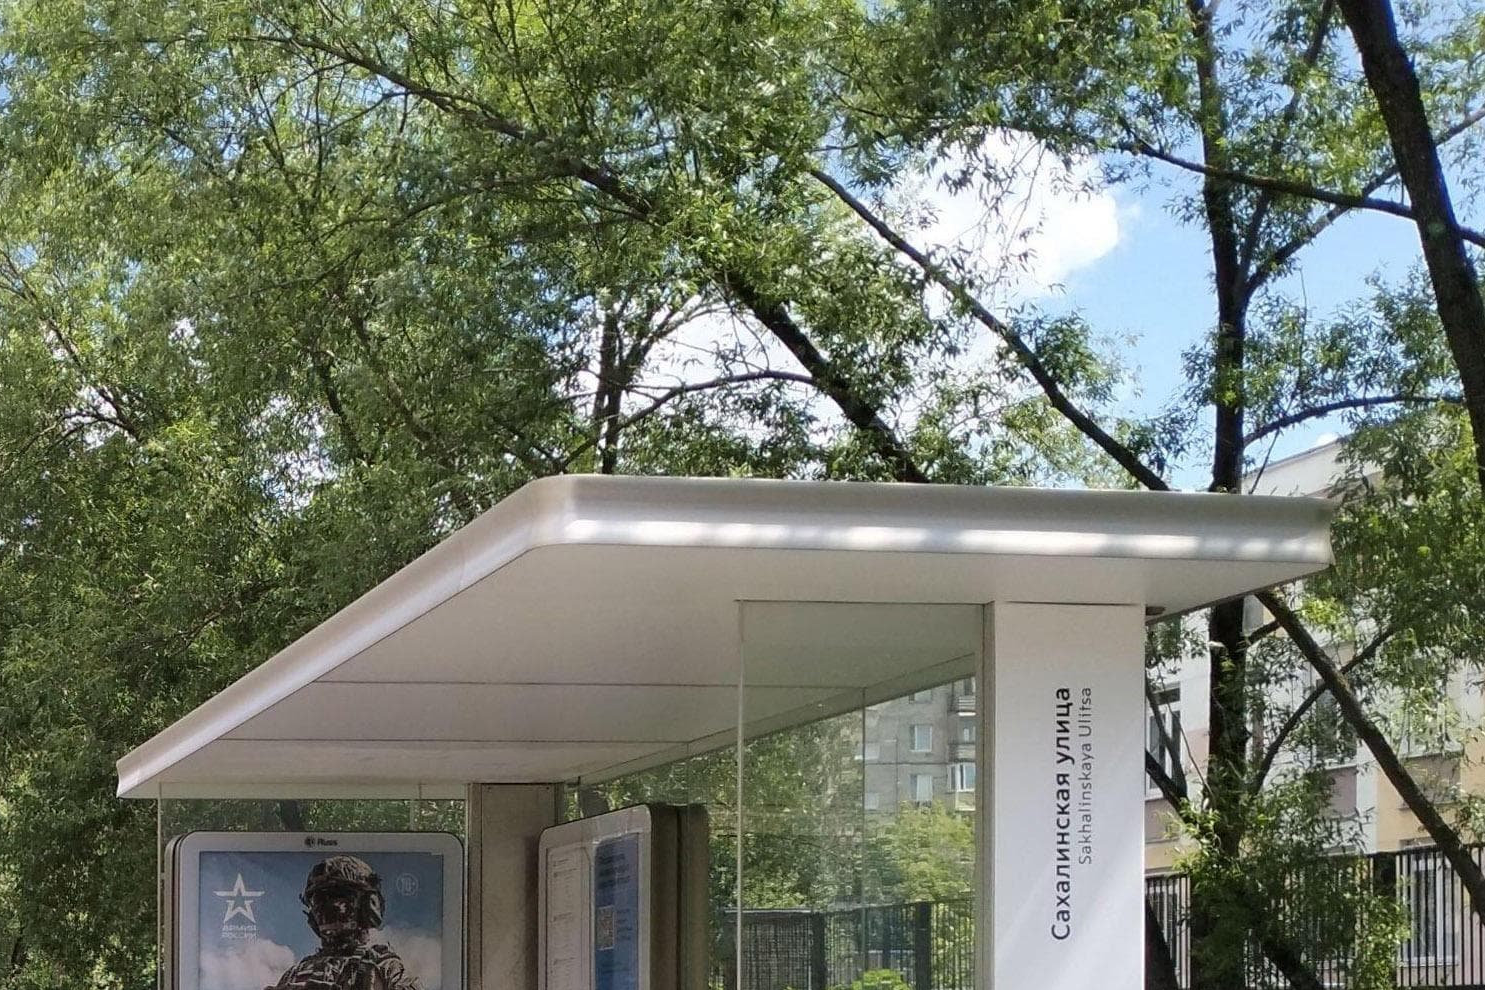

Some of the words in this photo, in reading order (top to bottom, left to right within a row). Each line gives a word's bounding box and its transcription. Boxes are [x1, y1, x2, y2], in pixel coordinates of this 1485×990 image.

[1056, 687, 1075, 765] улица
[1078, 687, 1092, 737] Ulitsa
[1078, 743, 1094, 865] Sakhalinskaya
[1051, 773, 1071, 940] Сахалинская
